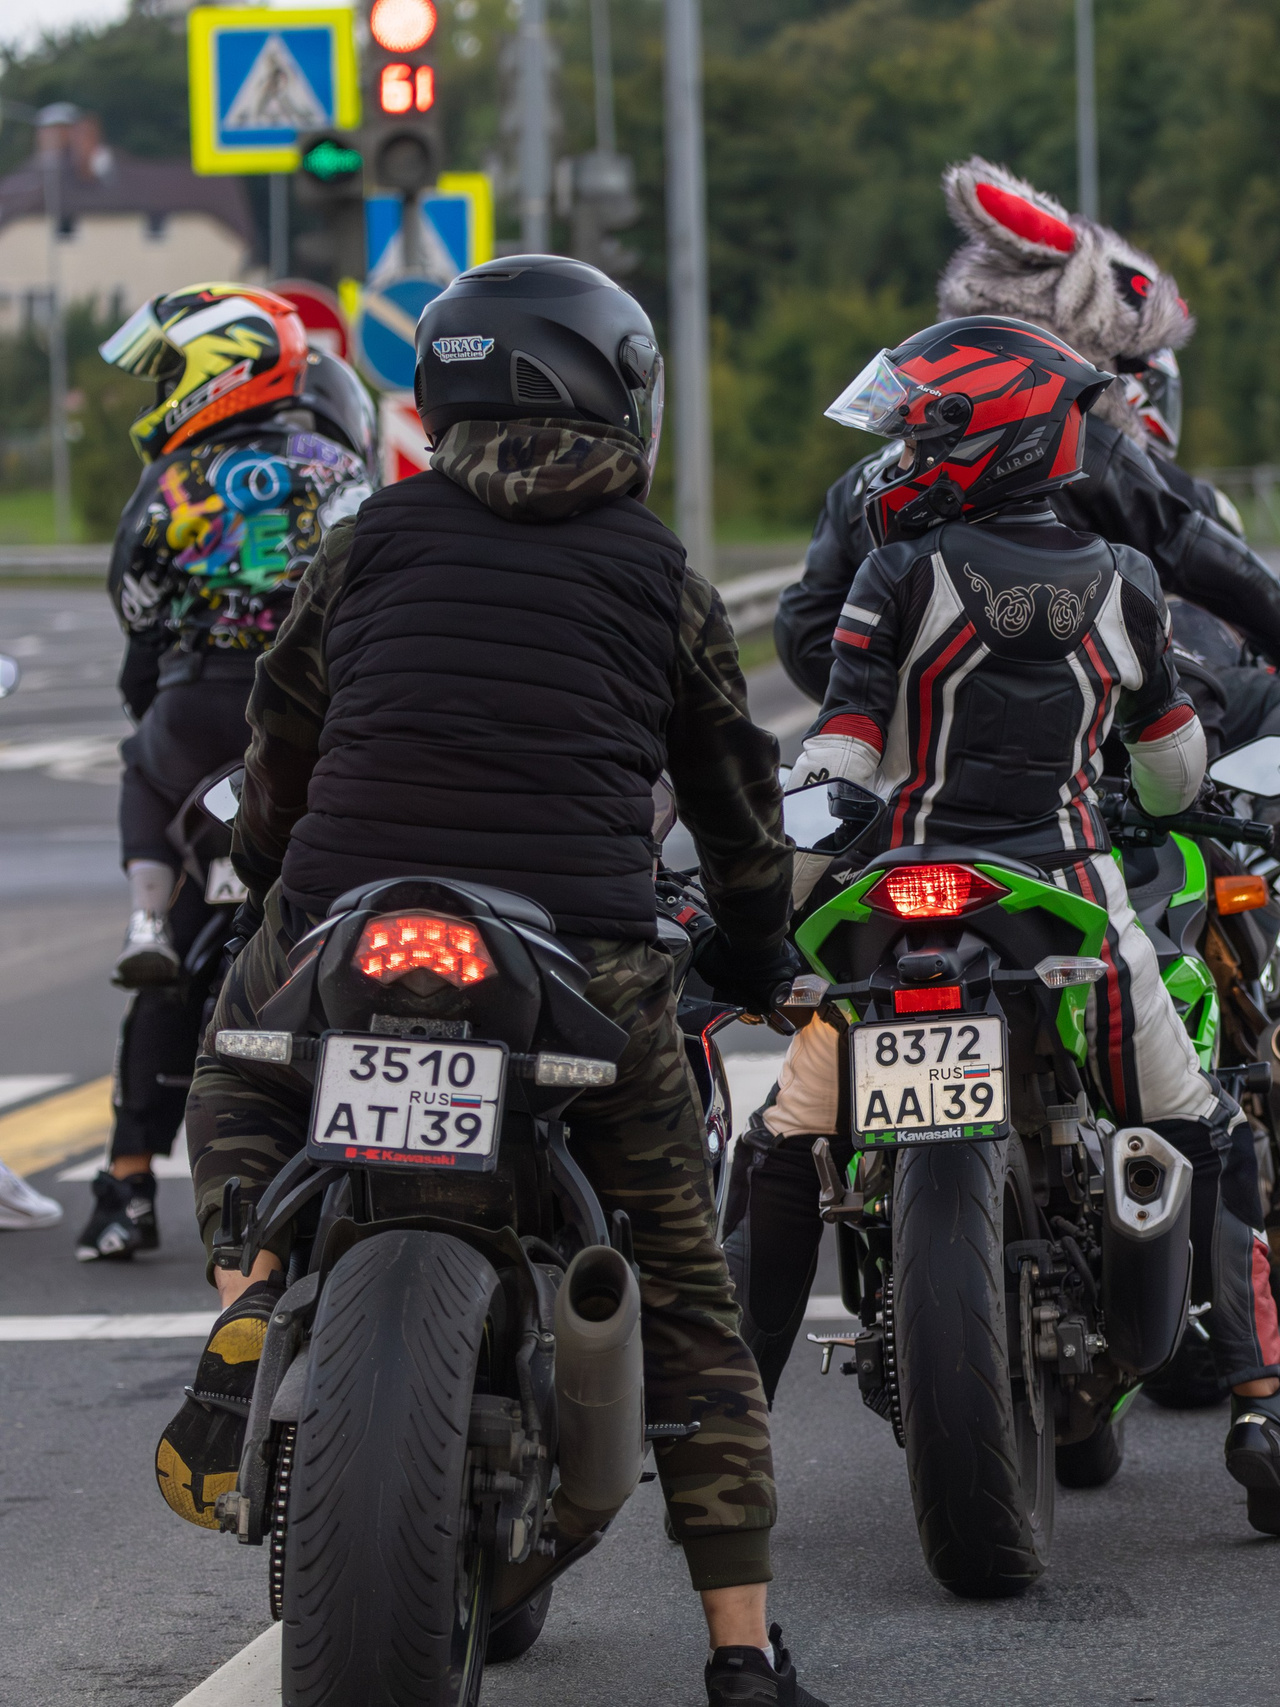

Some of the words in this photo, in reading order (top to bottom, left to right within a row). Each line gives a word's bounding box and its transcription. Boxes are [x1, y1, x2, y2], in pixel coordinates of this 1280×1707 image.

[381, 64, 434, 114] 61
[440, 338, 483, 353] DRAG
[996, 446, 1045, 475] AIROH
[876, 1025, 981, 1066] 8372
[350, 1044, 475, 1088] 3510
[929, 1067, 963, 1081] RUS
[410, 1090, 449, 1106] RUS
[864, 1086, 924, 1127] AA
[943, 1082, 994, 1120] 39
[324, 1103, 398, 1142] AT
[421, 1110, 482, 1148] 39
[897, 1127, 961, 1142] Kawasaki
[382, 1149, 456, 1166] Kawasaki
